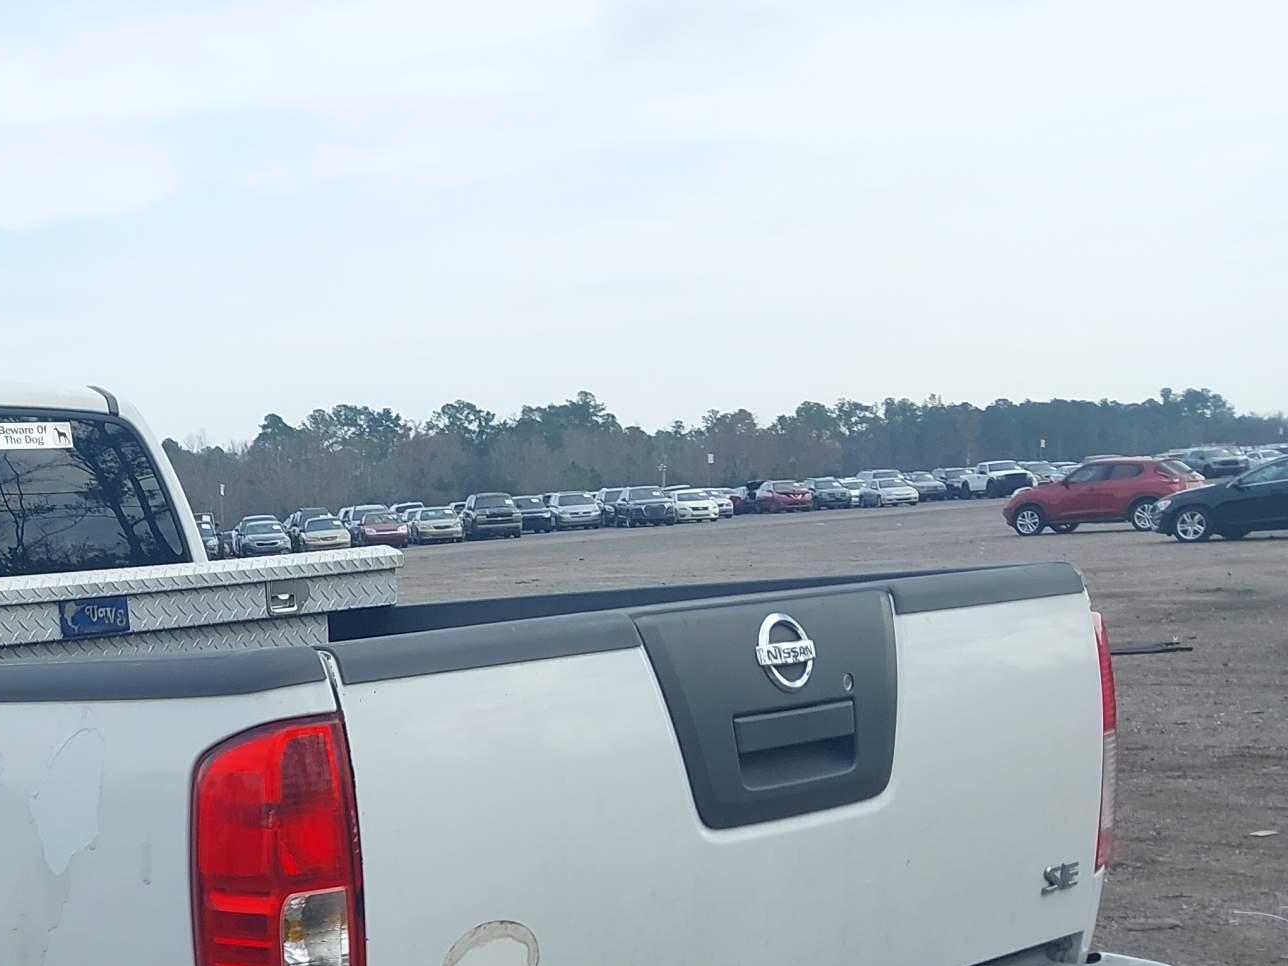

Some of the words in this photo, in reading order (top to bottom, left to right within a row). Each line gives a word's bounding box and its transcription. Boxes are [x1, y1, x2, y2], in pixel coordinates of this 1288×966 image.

[36, 425, 47, 434] Of
[3, 435, 22, 445] The
[24, 435, 44, 446] Dog
[766, 645, 813, 661] NISSAN
[1041, 861, 1080, 896] SE
